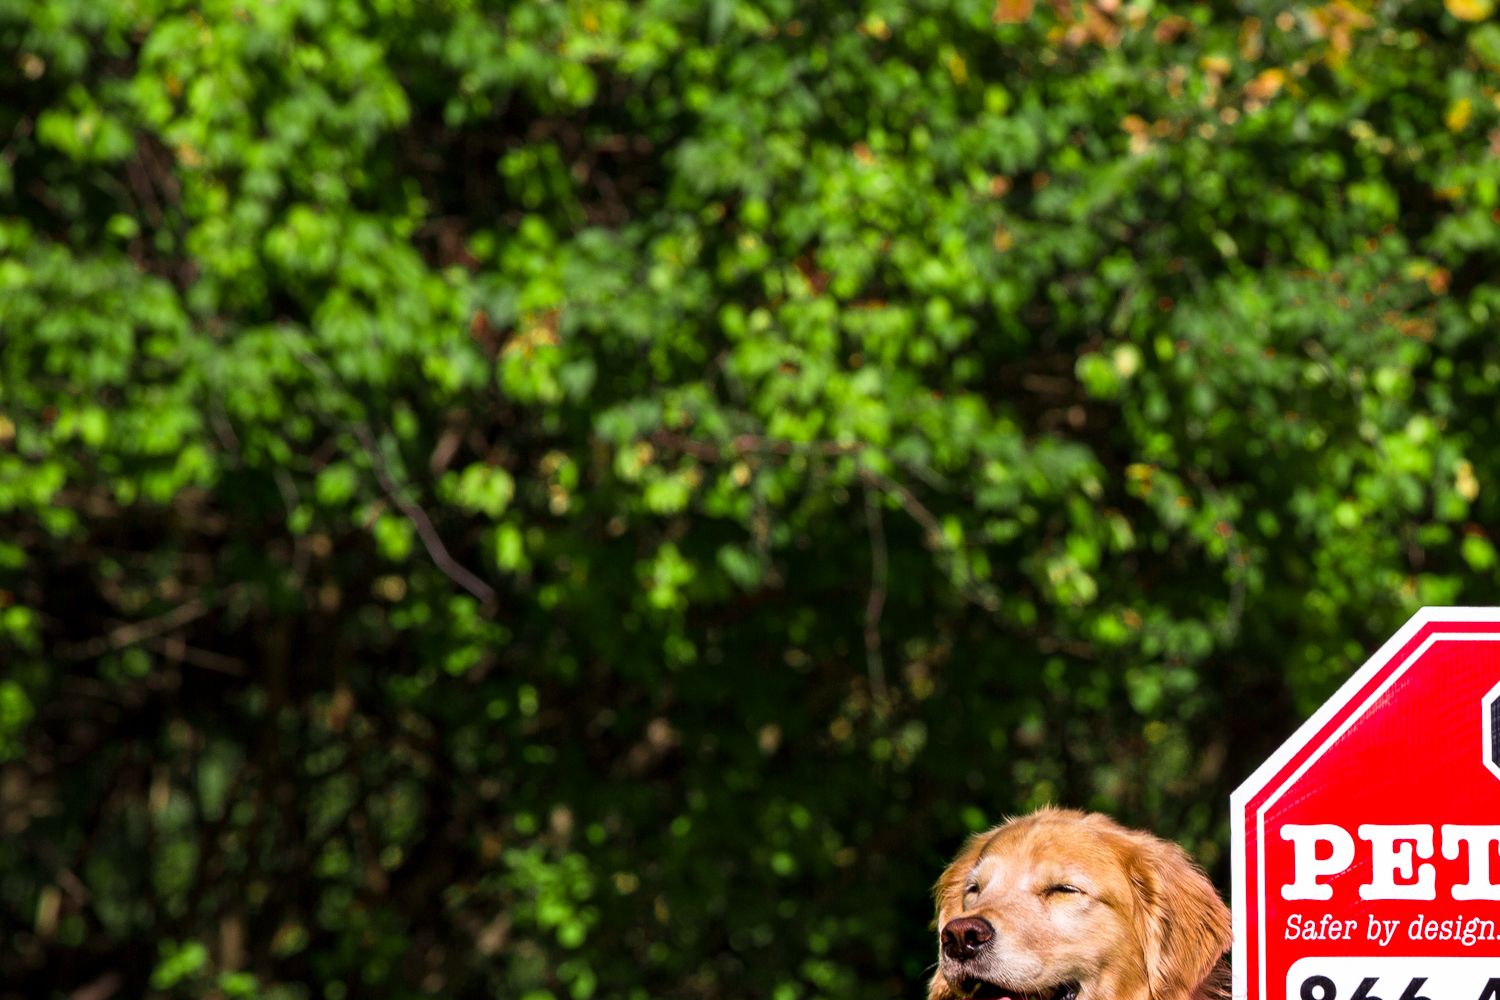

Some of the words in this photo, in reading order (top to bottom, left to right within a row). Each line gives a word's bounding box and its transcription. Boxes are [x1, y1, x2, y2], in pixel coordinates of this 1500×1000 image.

[1285, 914, 1357, 940] Safer
[1367, 914, 1400, 946] by
[1408, 914, 1500, 946] design.
